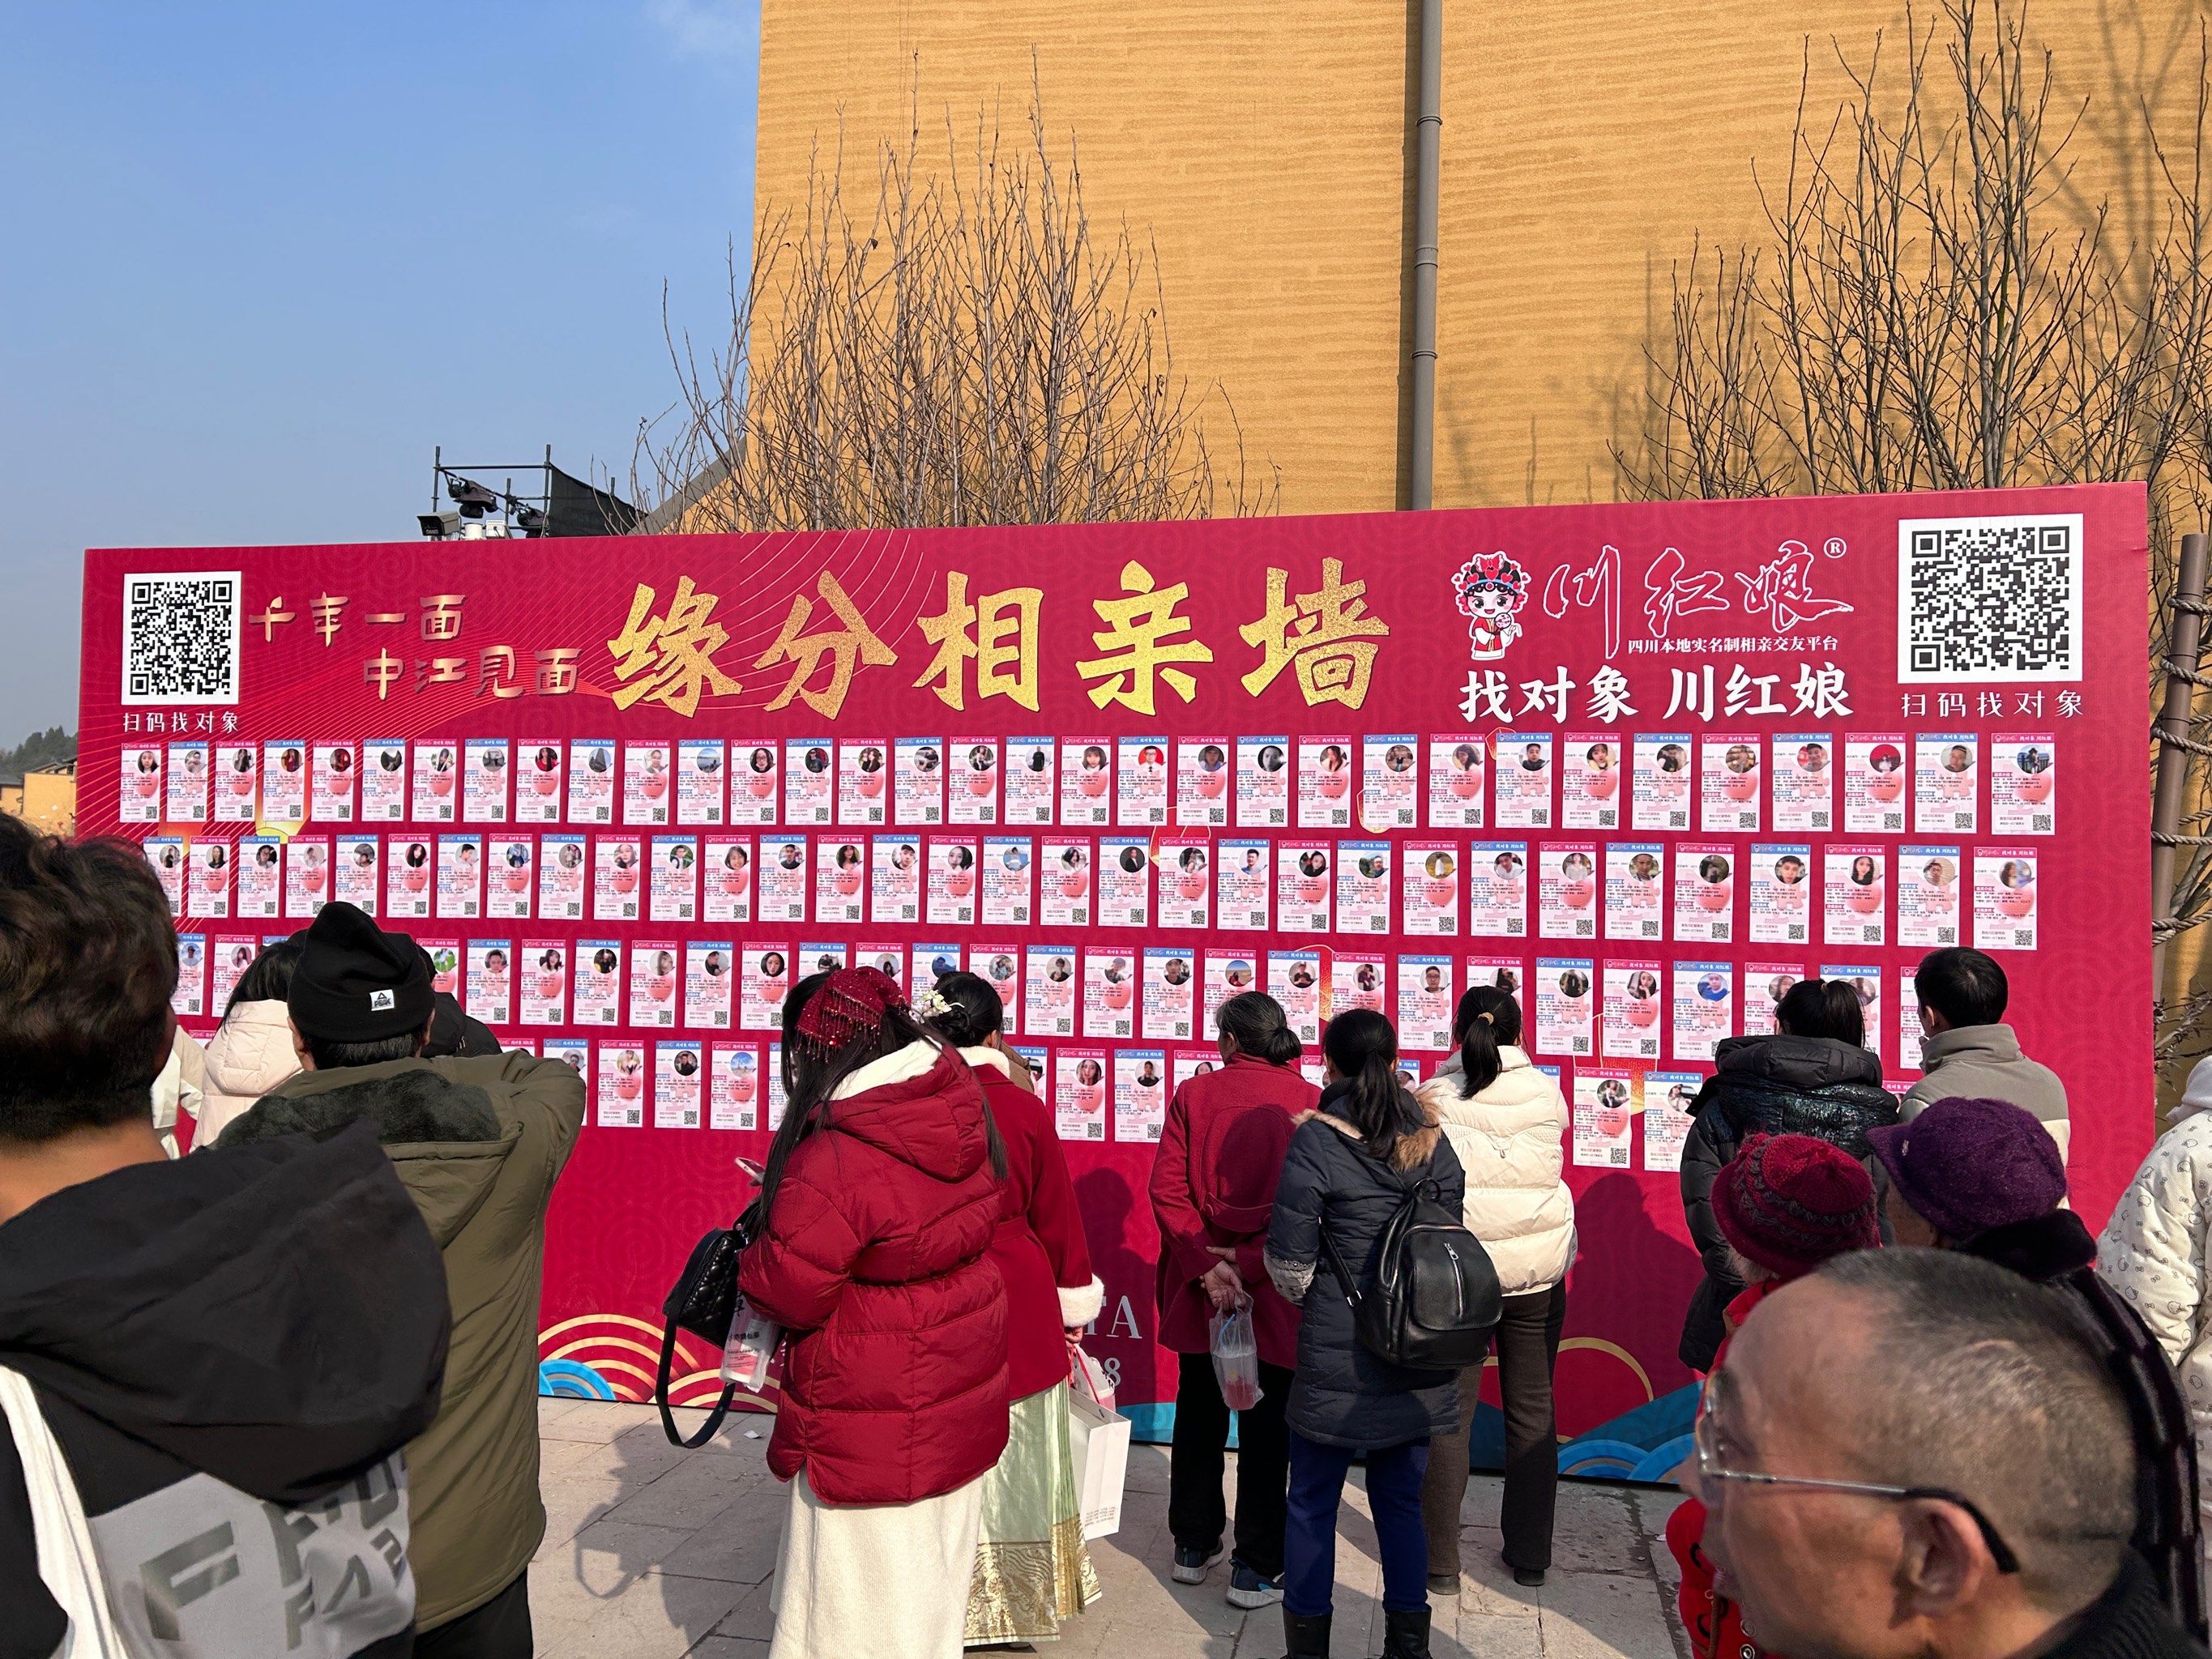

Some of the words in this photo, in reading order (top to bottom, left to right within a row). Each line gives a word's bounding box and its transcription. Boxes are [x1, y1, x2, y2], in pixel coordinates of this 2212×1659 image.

[248, 591, 468, 647] 千年一面
[609, 556, 1391, 719] 缘分相亲墙
[1628, 635, 1839, 655] 四川本地实名制相亲交友平台
[362, 647, 582, 701] 中江见面
[1458, 663, 1640, 725] 找对象
[1661, 661, 1855, 723] 川红娘
[122, 710, 240, 734] 扫码找对象
[1901, 691, 2083, 720] 扫码找对象
